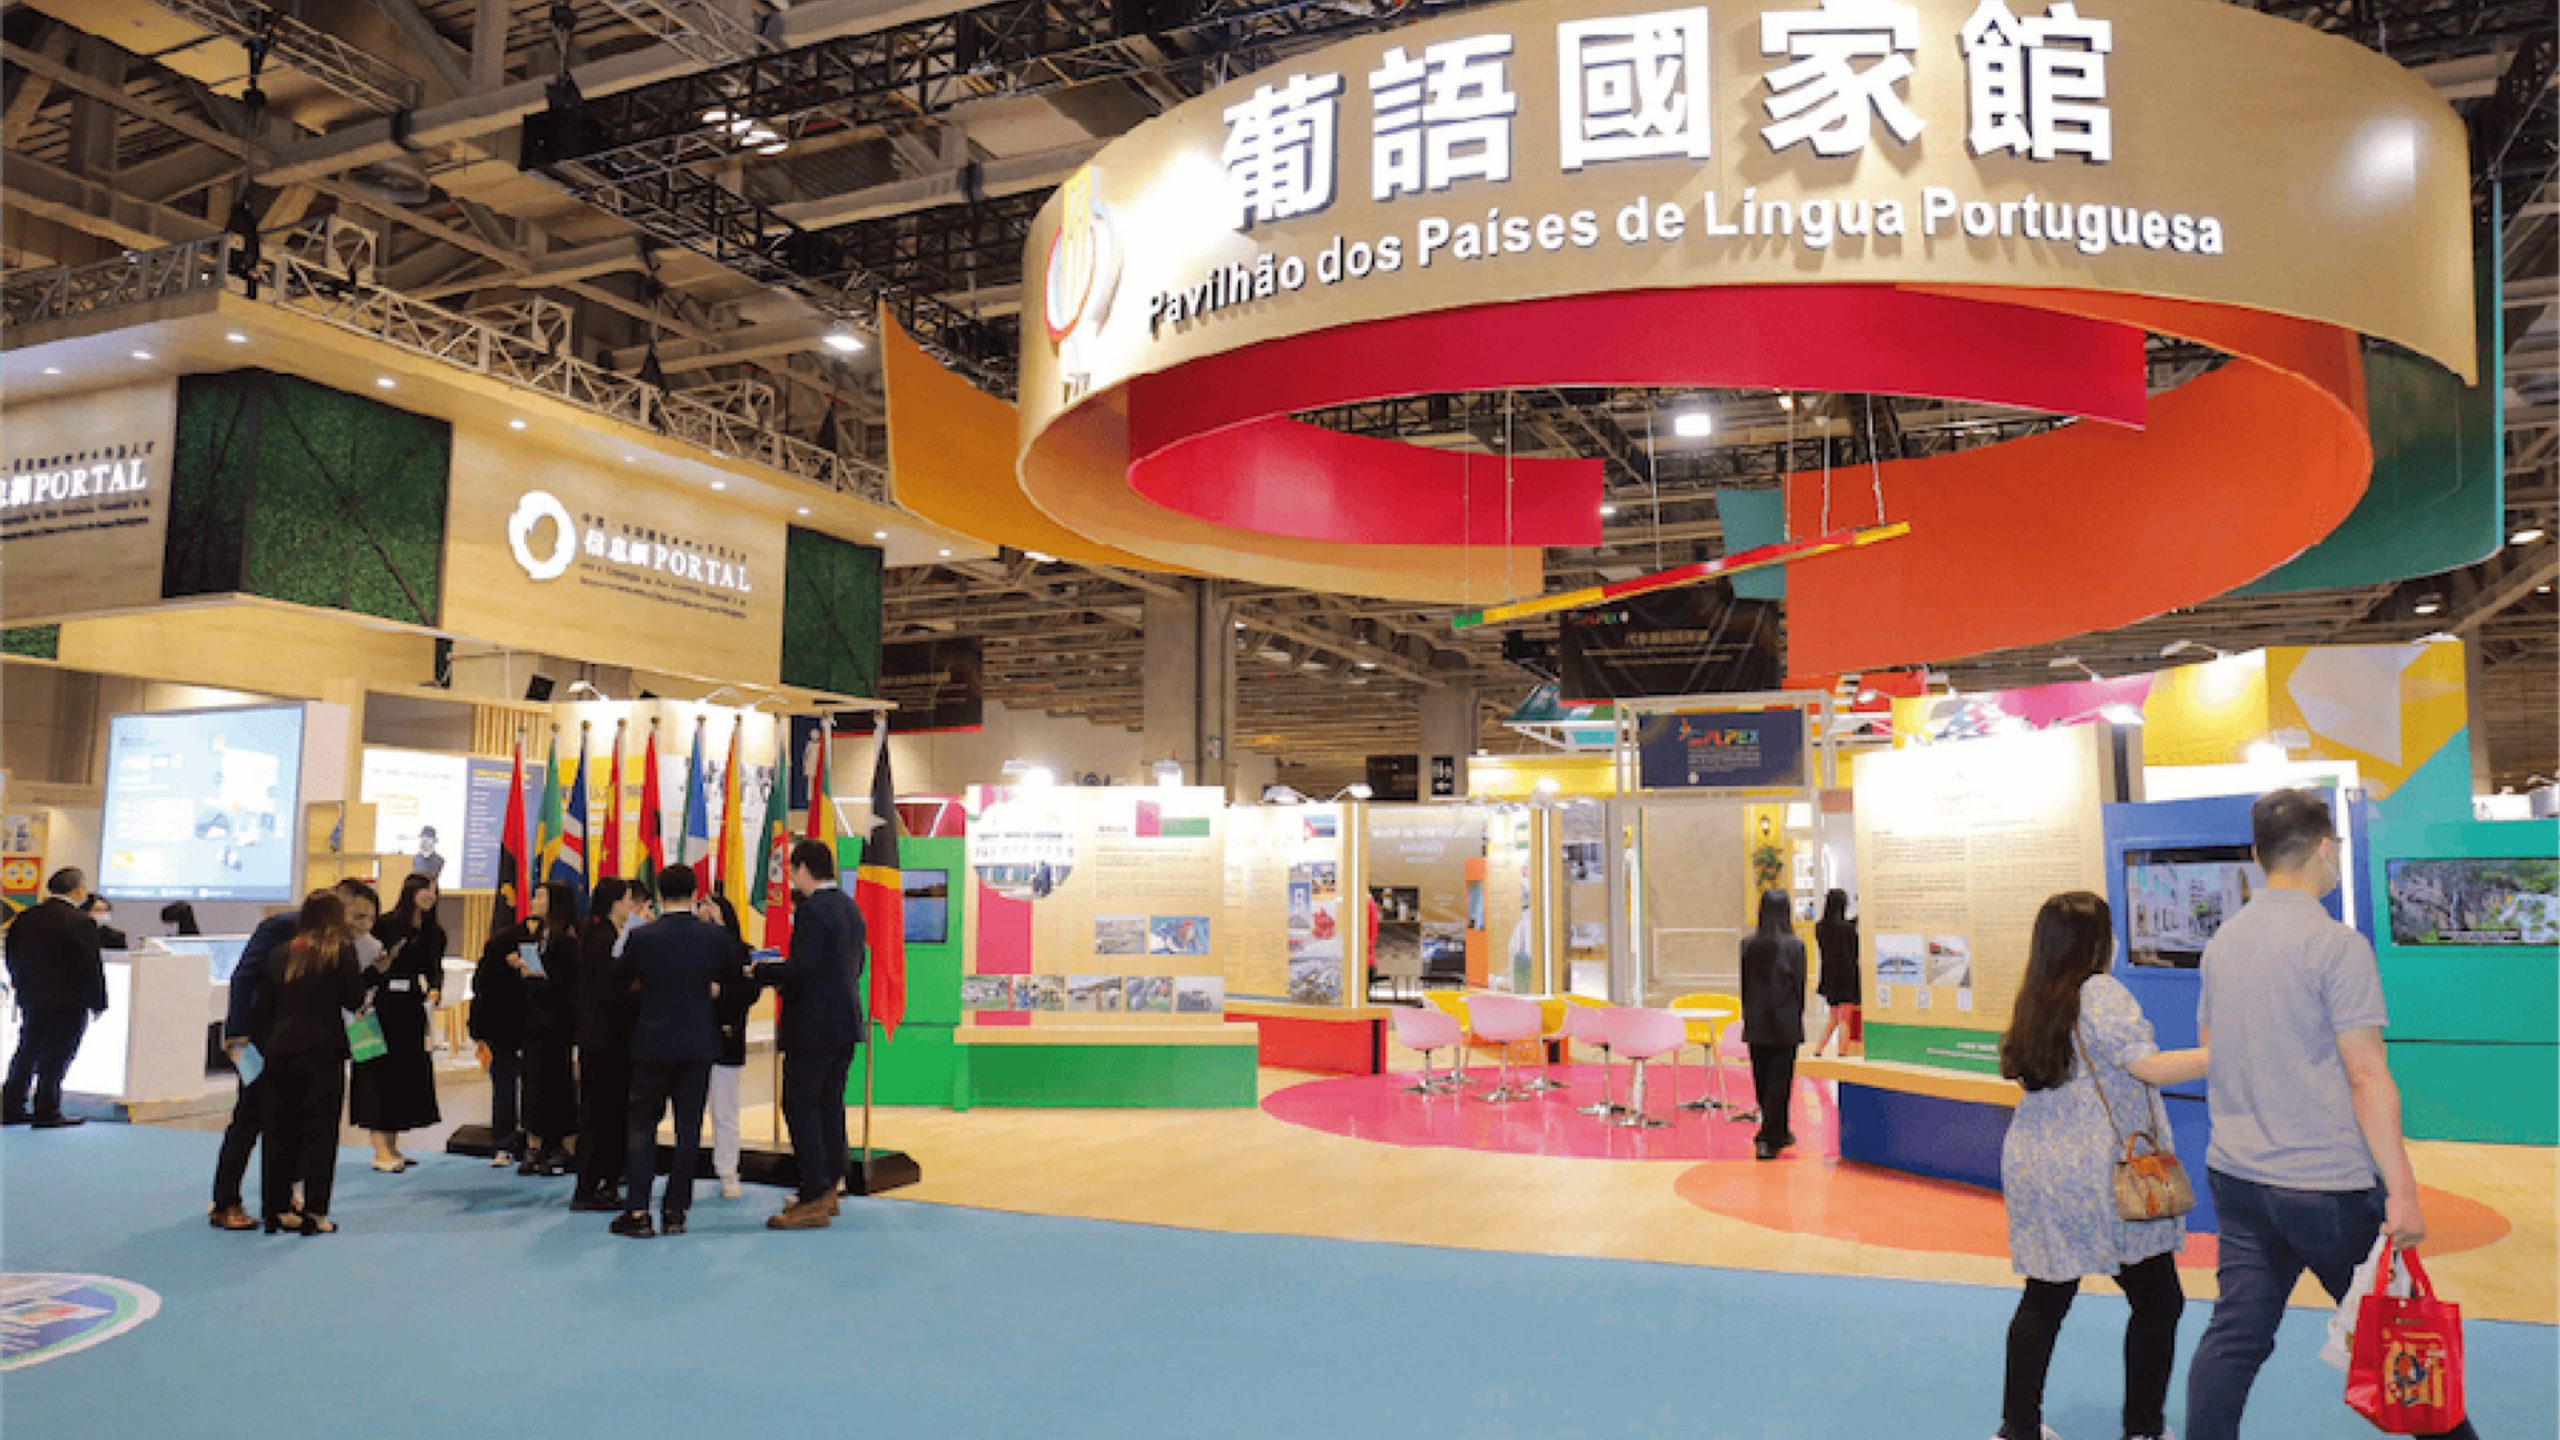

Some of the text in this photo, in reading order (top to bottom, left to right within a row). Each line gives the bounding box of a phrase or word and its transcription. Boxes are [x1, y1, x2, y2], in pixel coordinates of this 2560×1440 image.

[1221, 0, 2113, 229] 葡語國家館
[1150, 186, 2224, 334] Pavilhão dos Países de Língua Portuguesa
[34, 458, 147, 503] PORTAL
[653, 542, 752, 593] PORTAL
